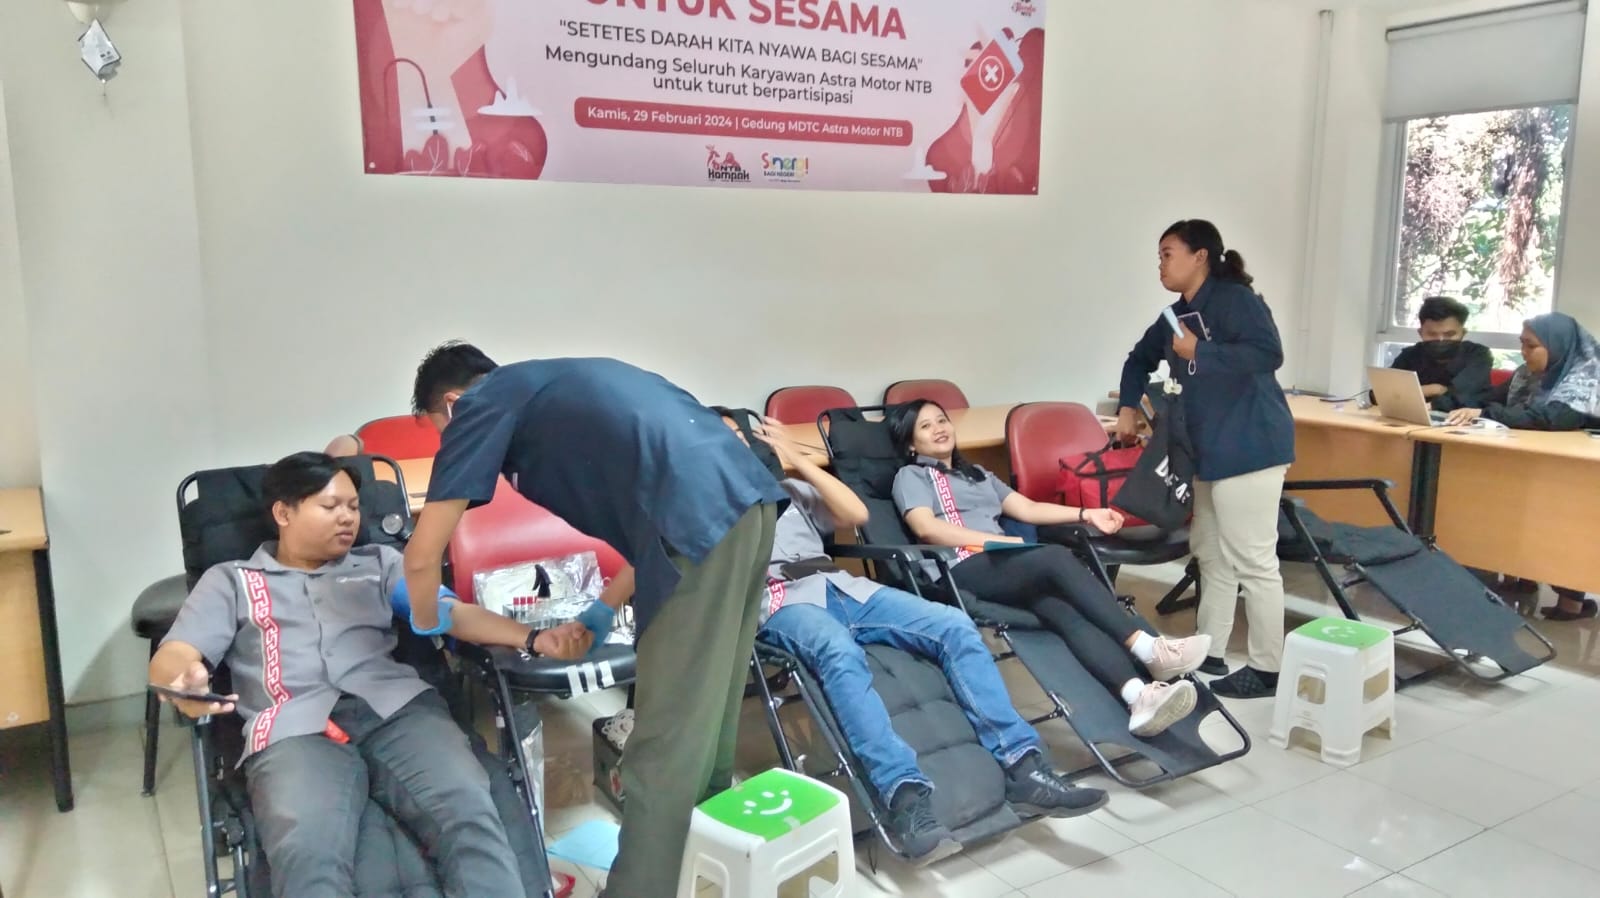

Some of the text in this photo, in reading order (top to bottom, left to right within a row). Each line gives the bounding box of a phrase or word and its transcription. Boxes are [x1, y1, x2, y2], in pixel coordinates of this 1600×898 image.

[749, 0, 907, 40] SESAMA
[559, 19, 923, 71] "SETETES DARAH KITA NYAWA BAGI SESAMA"
[545, 45, 932, 94] Mengundang Seluruh Karyawan Astra Motor NTB
[653, 76, 853, 105] untuk turut berpartisipasi
[587, 106, 630, 122] Kamis,
[633, 110, 648, 122] 29
[651, 111, 701, 125] Februari
[704, 114, 732, 127] 2024
[741, 117, 785, 133] Gedung
[788, 121, 820, 132] MDTC
[822, 124, 849, 135] Astra
[851, 125, 881, 137] Motor
[883, 127, 904, 138] NTB
